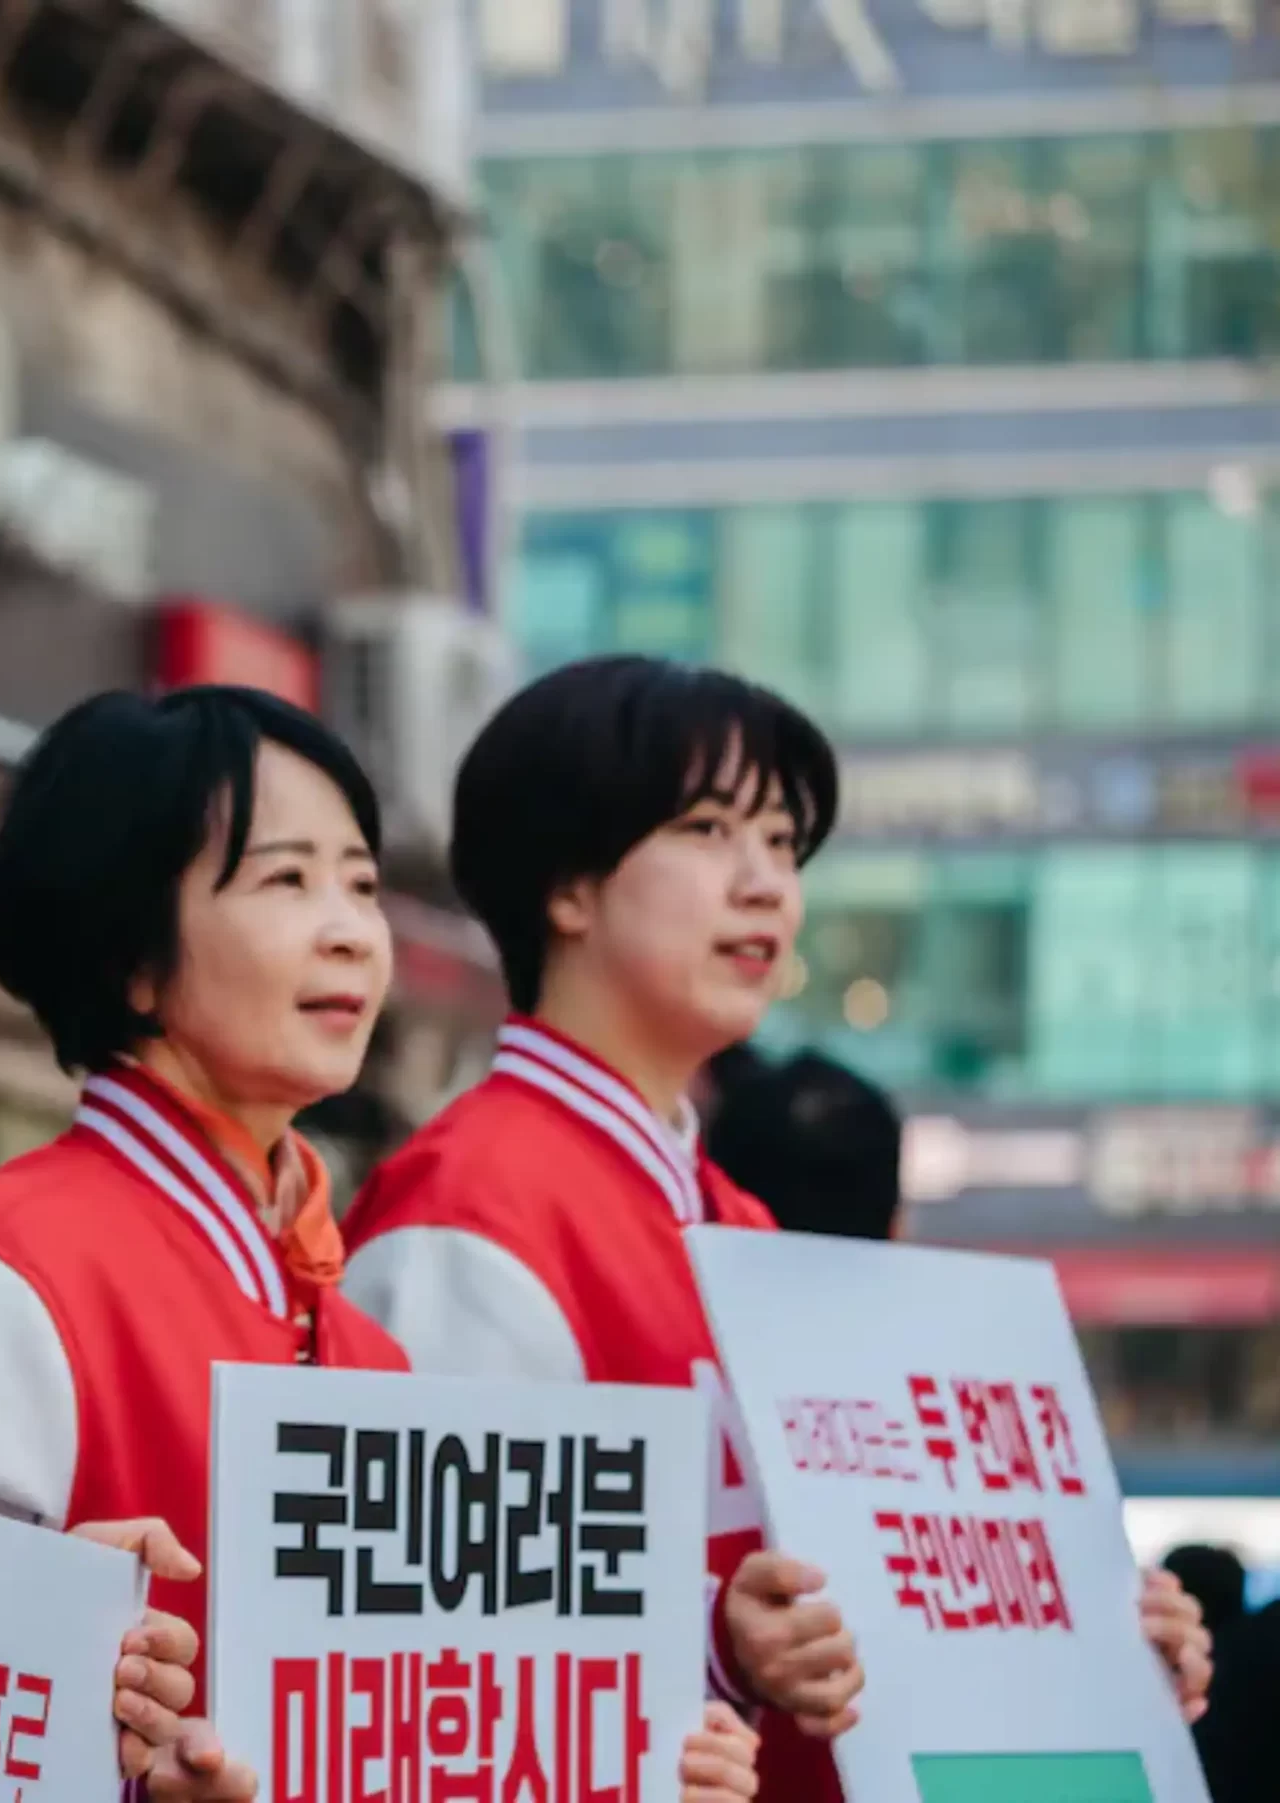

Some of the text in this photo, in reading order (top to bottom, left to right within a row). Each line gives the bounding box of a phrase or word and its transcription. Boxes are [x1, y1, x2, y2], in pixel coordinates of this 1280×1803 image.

[907, 1375, 957, 1491] 두
[1026, 1384, 1086, 1497] 칸
[273, 1422, 646, 1616] 국민여러분
[873, 1510, 1072, 1632] 국민의미래
[272, 1648, 650, 1803] 미래합시다
